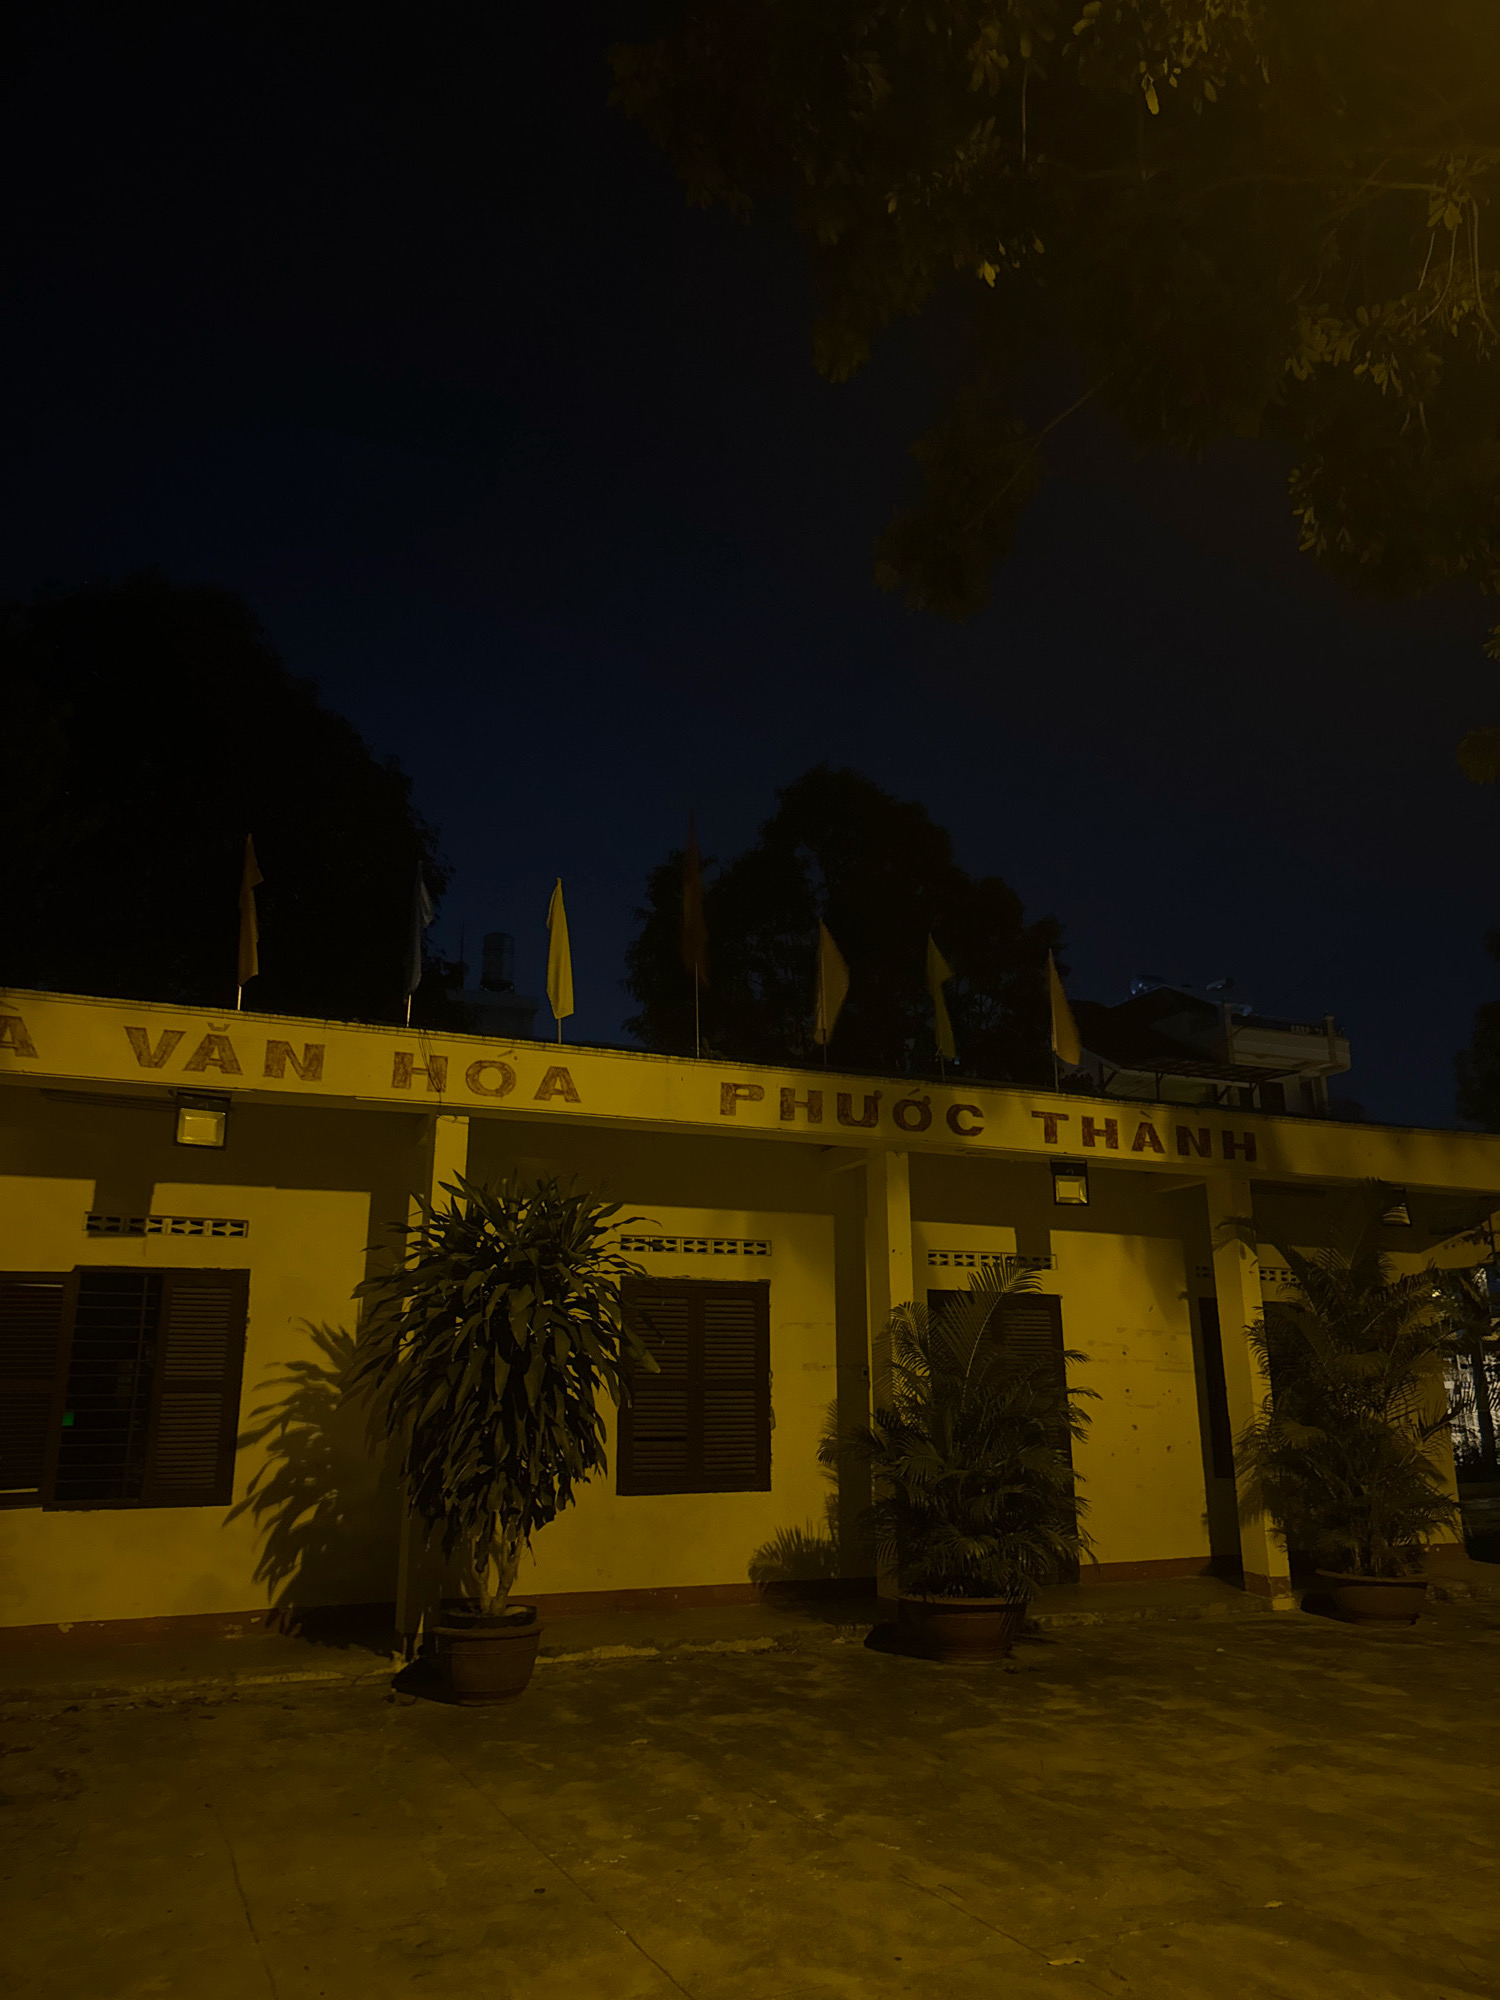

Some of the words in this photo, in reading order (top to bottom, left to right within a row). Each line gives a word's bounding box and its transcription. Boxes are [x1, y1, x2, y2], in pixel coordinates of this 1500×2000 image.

[123, 1022, 326, 1081] VĂN
[391, 1050, 582, 1103] HÓA
[719, 1081, 985, 1137] PHƯỚC
[1031, 1110, 1258, 1162] THÀNH
